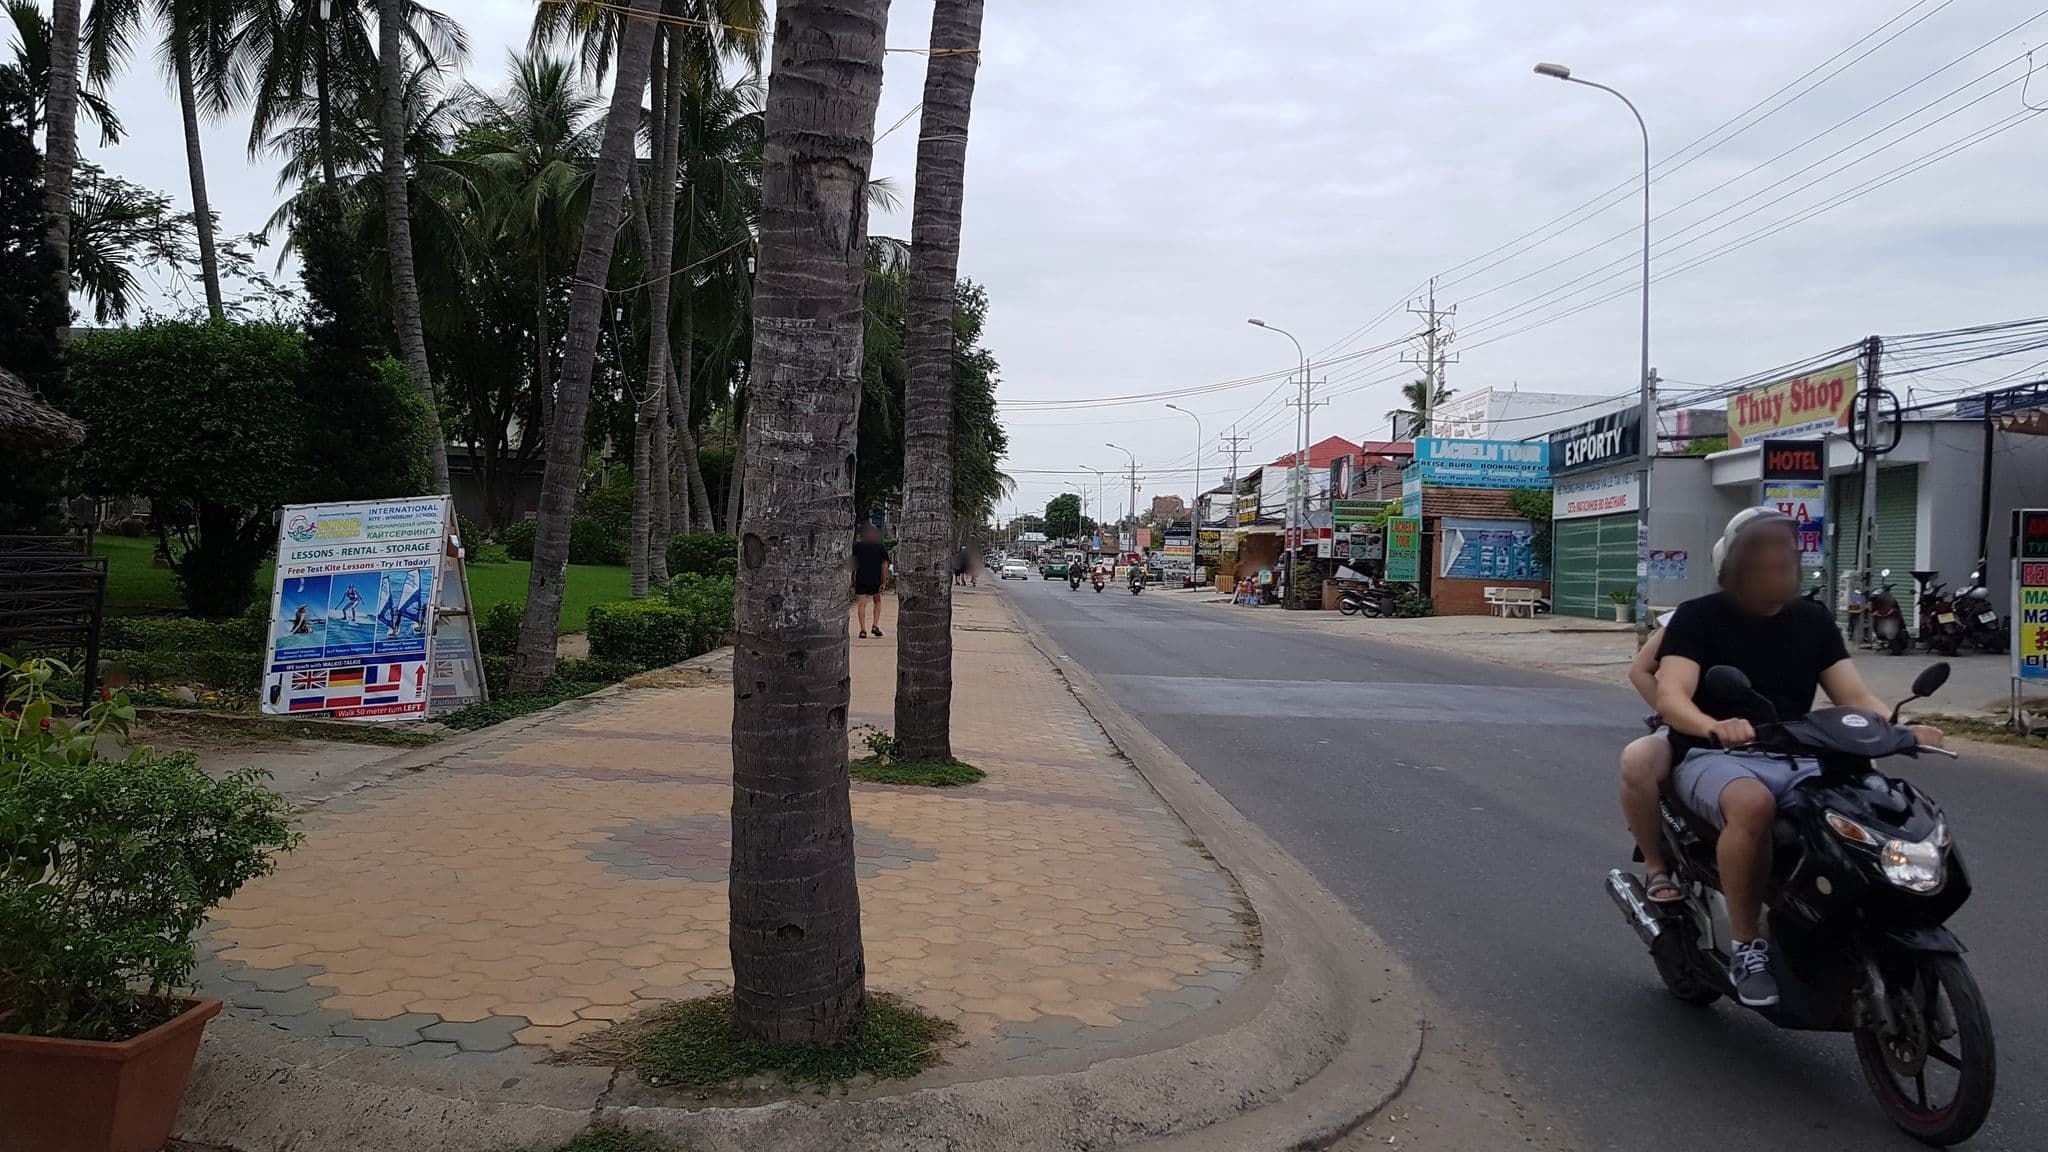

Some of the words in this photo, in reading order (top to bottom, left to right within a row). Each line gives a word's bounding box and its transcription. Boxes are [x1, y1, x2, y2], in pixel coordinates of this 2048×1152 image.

[1790, 376, 1844, 415] Shop
[1501, 444, 1541, 462] TOUR
[1565, 426, 1623, 467] EXPORTY
[1420, 460, 1444, 468] REISE
[1481, 463, 1518, 471] BOOKING
[1768, 450, 1819, 470] HOTEL
[369, 504, 438, 515] INTERNATIONAL
[366, 528, 436, 540] КАЙТСЕРФИНГА
[291, 548, 333, 560] LESSONS
[341, 546, 378, 556] RENTAL
[386, 542, 431, 554] STORAGE
[288, 567, 305, 575] Free
[306, 565, 322, 573] Test
[324, 563, 341, 572] Kite
[342, 562, 374, 571] Lessons
[381, 560, 394, 569] Try
[395, 559, 402, 567] It
[404, 558, 431, 568] Today!
[295, 662, 310, 670] teach
[338, 709, 355, 718] Walk
[356, 708, 365, 716] 50
[366, 707, 388, 715] meter
[388, 705, 402, 714] turn
[403, 703, 421, 712] LEFT
